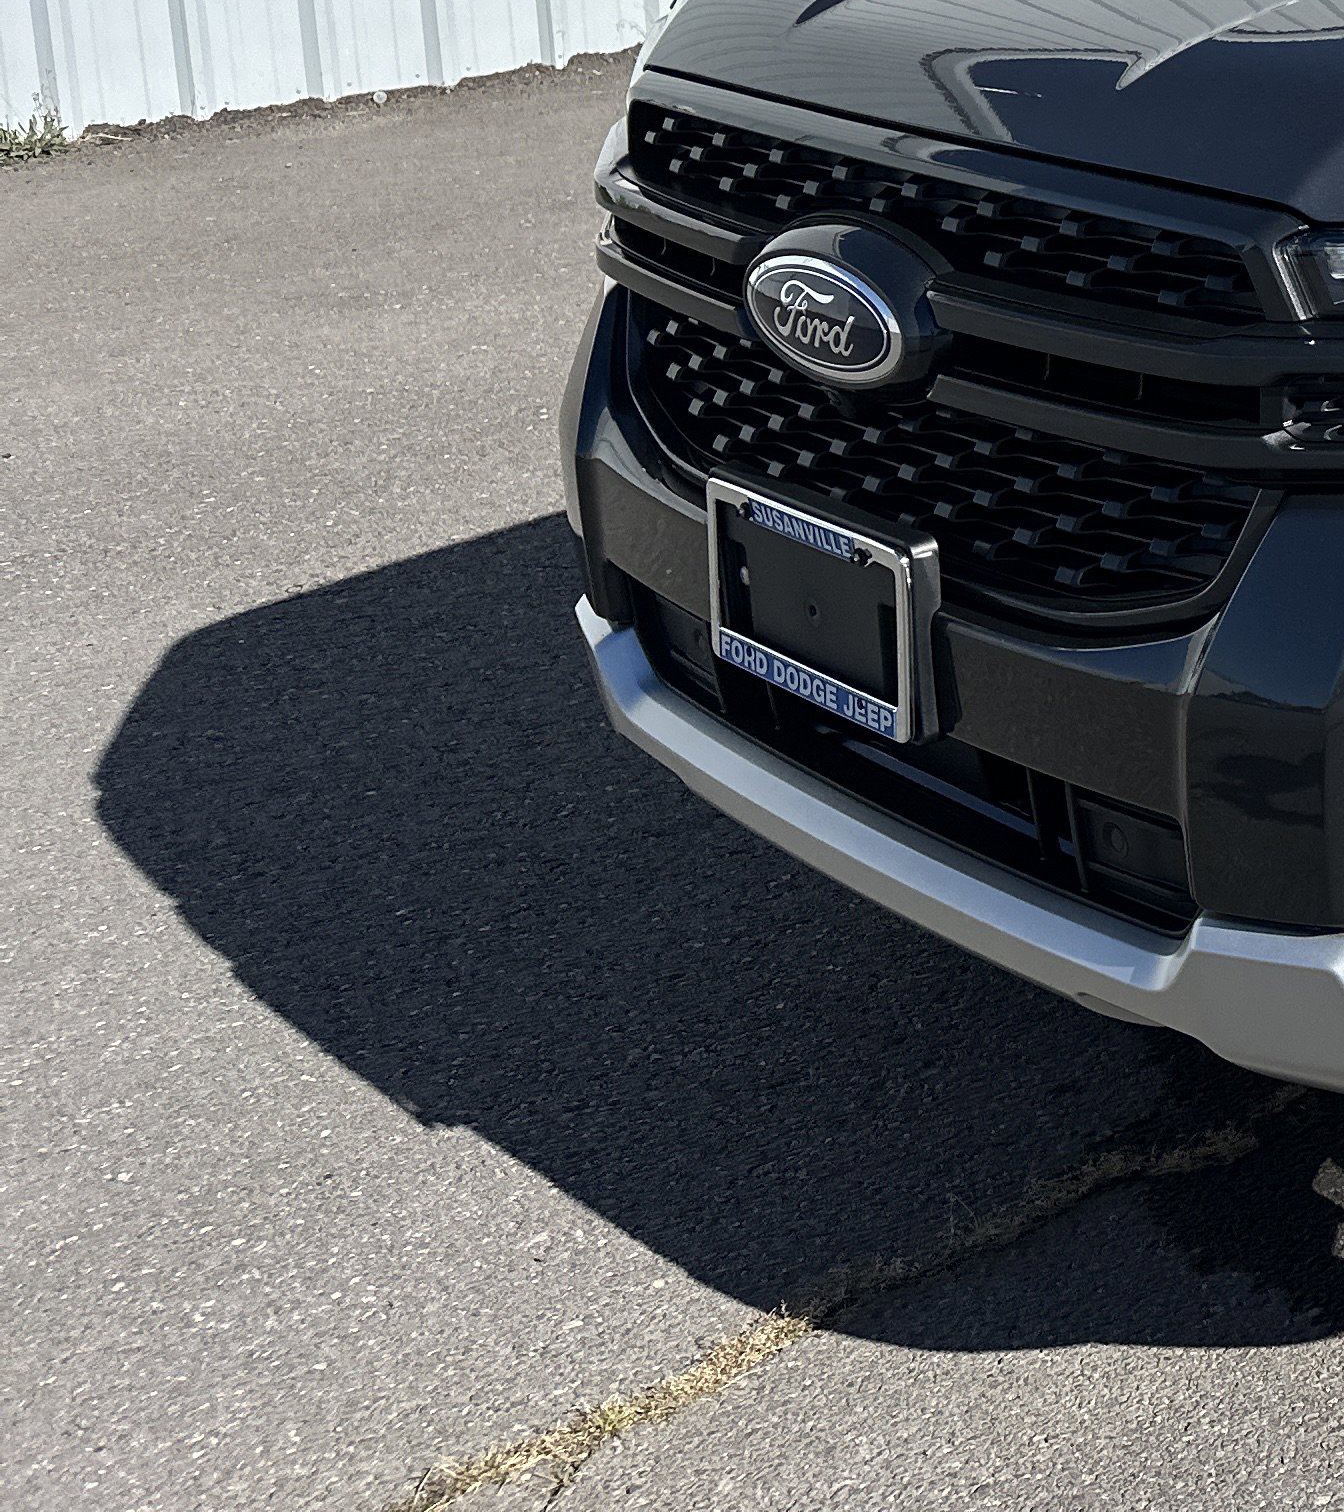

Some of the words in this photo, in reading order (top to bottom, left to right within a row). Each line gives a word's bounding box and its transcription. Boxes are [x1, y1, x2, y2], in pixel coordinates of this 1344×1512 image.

[773, 279, 856, 357] Ford
[751, 501, 852, 557] SUSANVILLE
[720, 635, 769, 676] FORD
[773, 664, 839, 710] DODGE
[843, 693, 894, 733] JEEP
